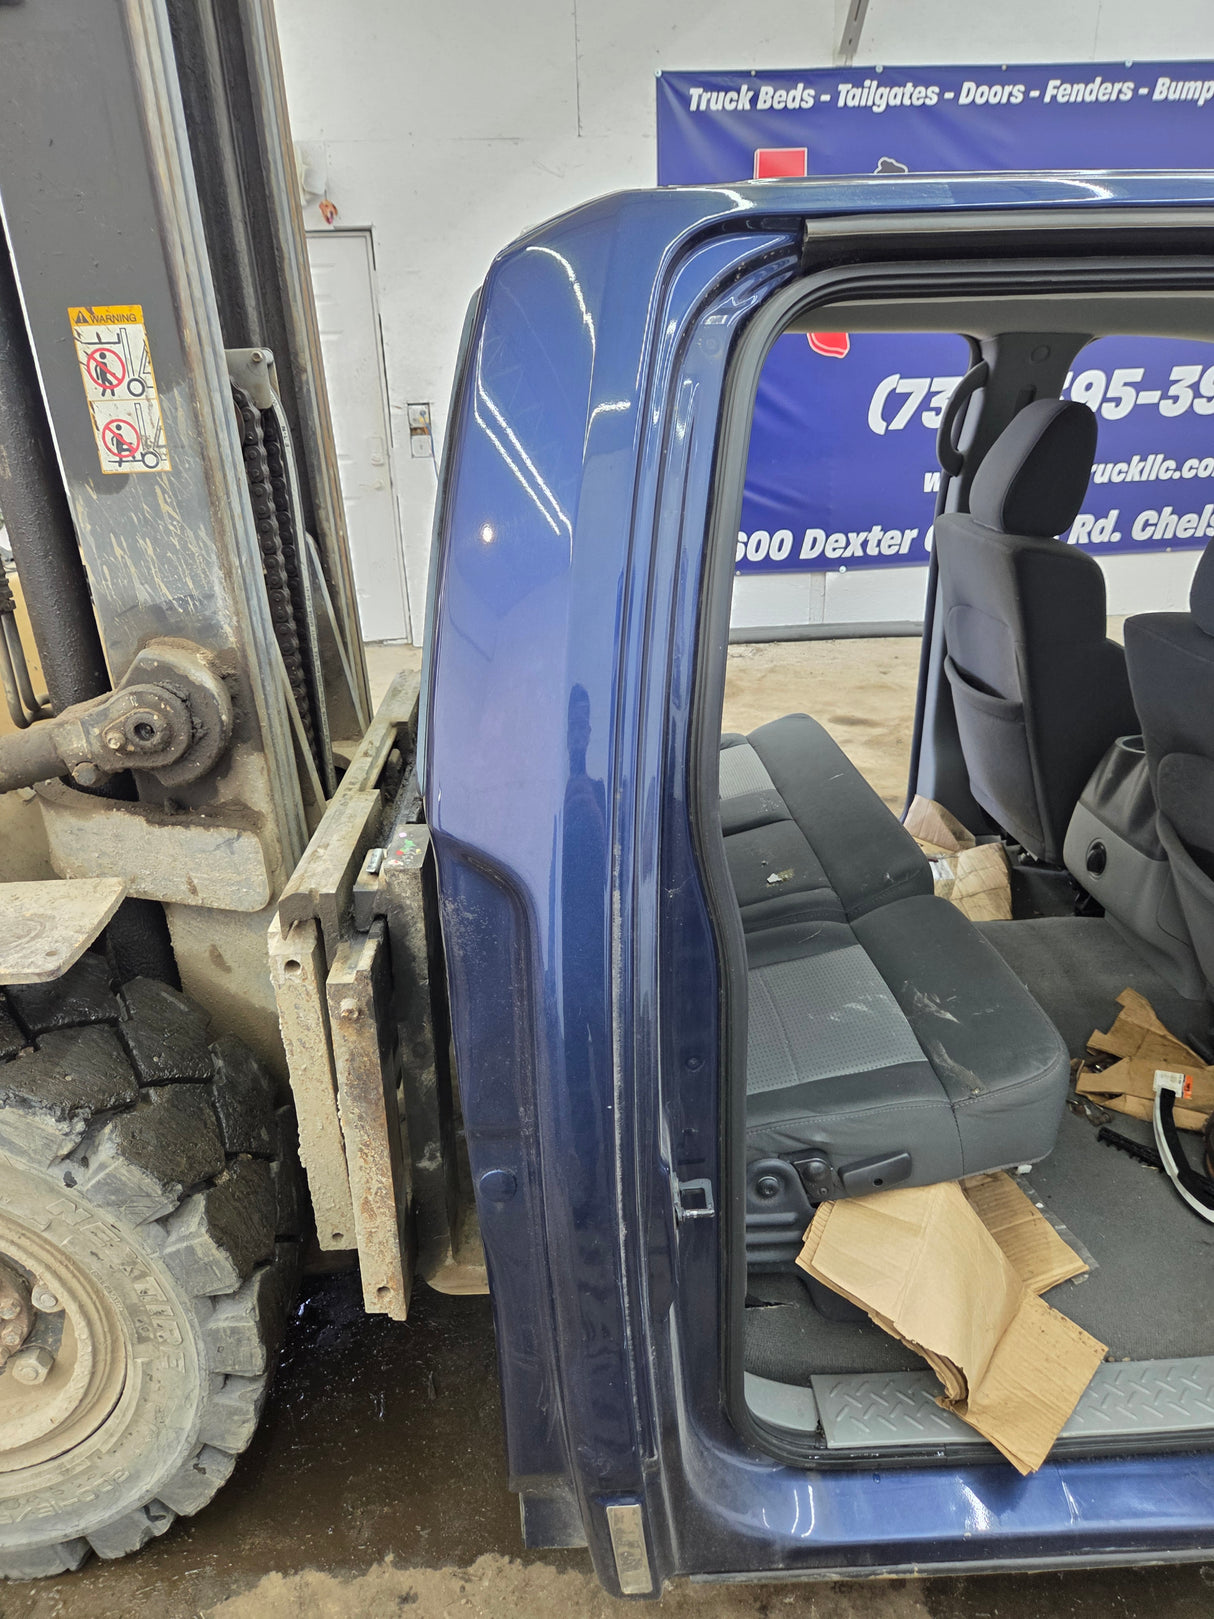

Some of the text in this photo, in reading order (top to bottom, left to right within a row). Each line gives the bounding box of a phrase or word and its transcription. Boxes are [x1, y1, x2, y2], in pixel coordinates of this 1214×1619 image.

[689, 84, 754, 111] Truck
[756, 83, 815, 110] Beds
[837, 79, 939, 113] Tailgates
[958, 81, 1025, 105] Doors
[1043, 77, 1135, 103] Fenders
[1152, 77, 1214, 106] Bump
[90, 313, 137, 324] WARNING
[868, 365, 1214, 435] (73 95-3
[1091, 453, 1214, 484] uckllc.co
[799, 525, 919, 560] Dexter
[1066, 508, 1122, 545] Rd.
